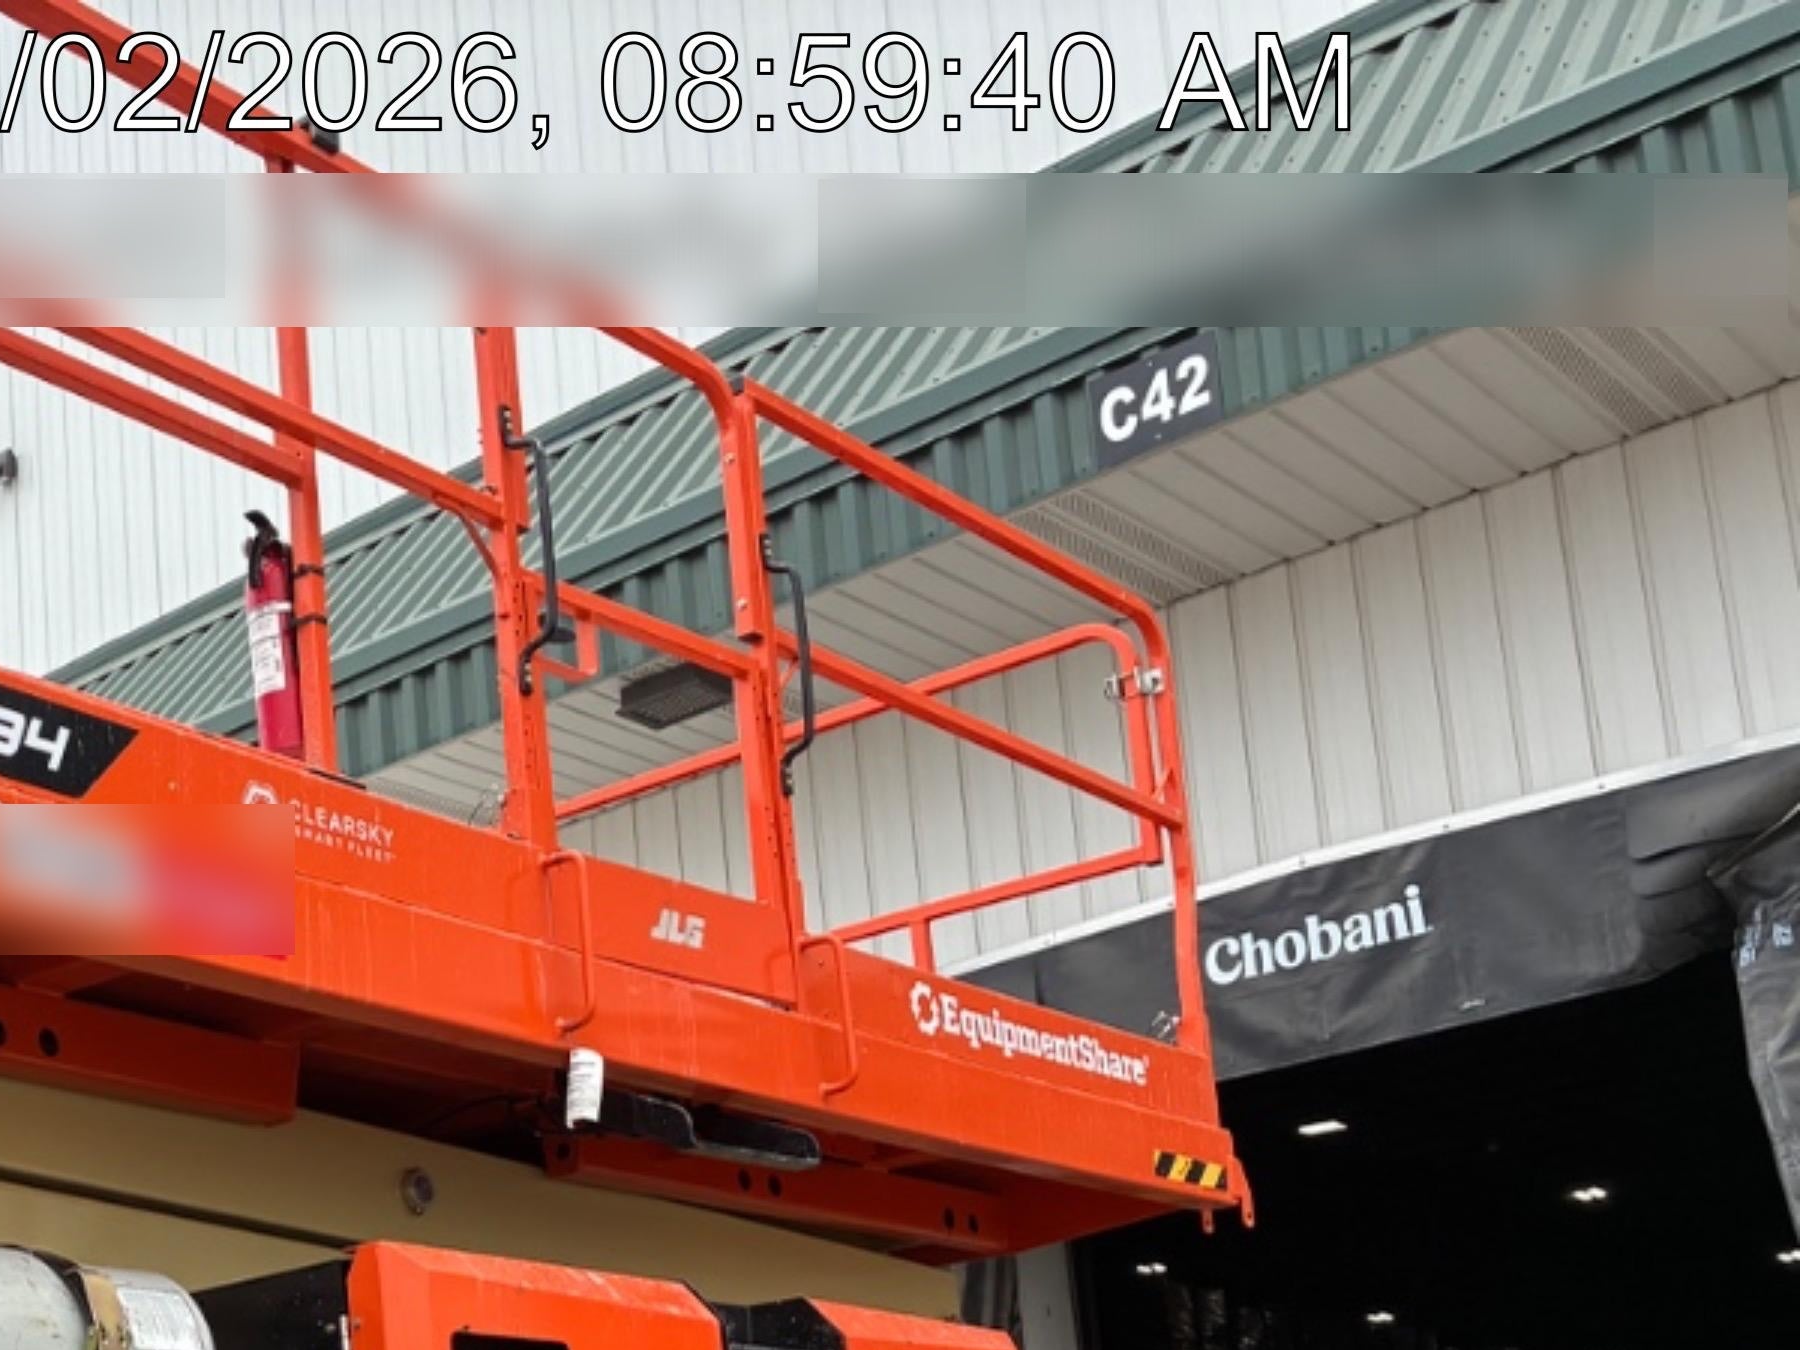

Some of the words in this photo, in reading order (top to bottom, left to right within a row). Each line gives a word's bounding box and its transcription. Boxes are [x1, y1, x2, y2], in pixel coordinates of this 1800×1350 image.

[1101, 353, 1211, 441] C42
[650, 907, 706, 950] JLG
[1205, 884, 1428, 985] Chobani
